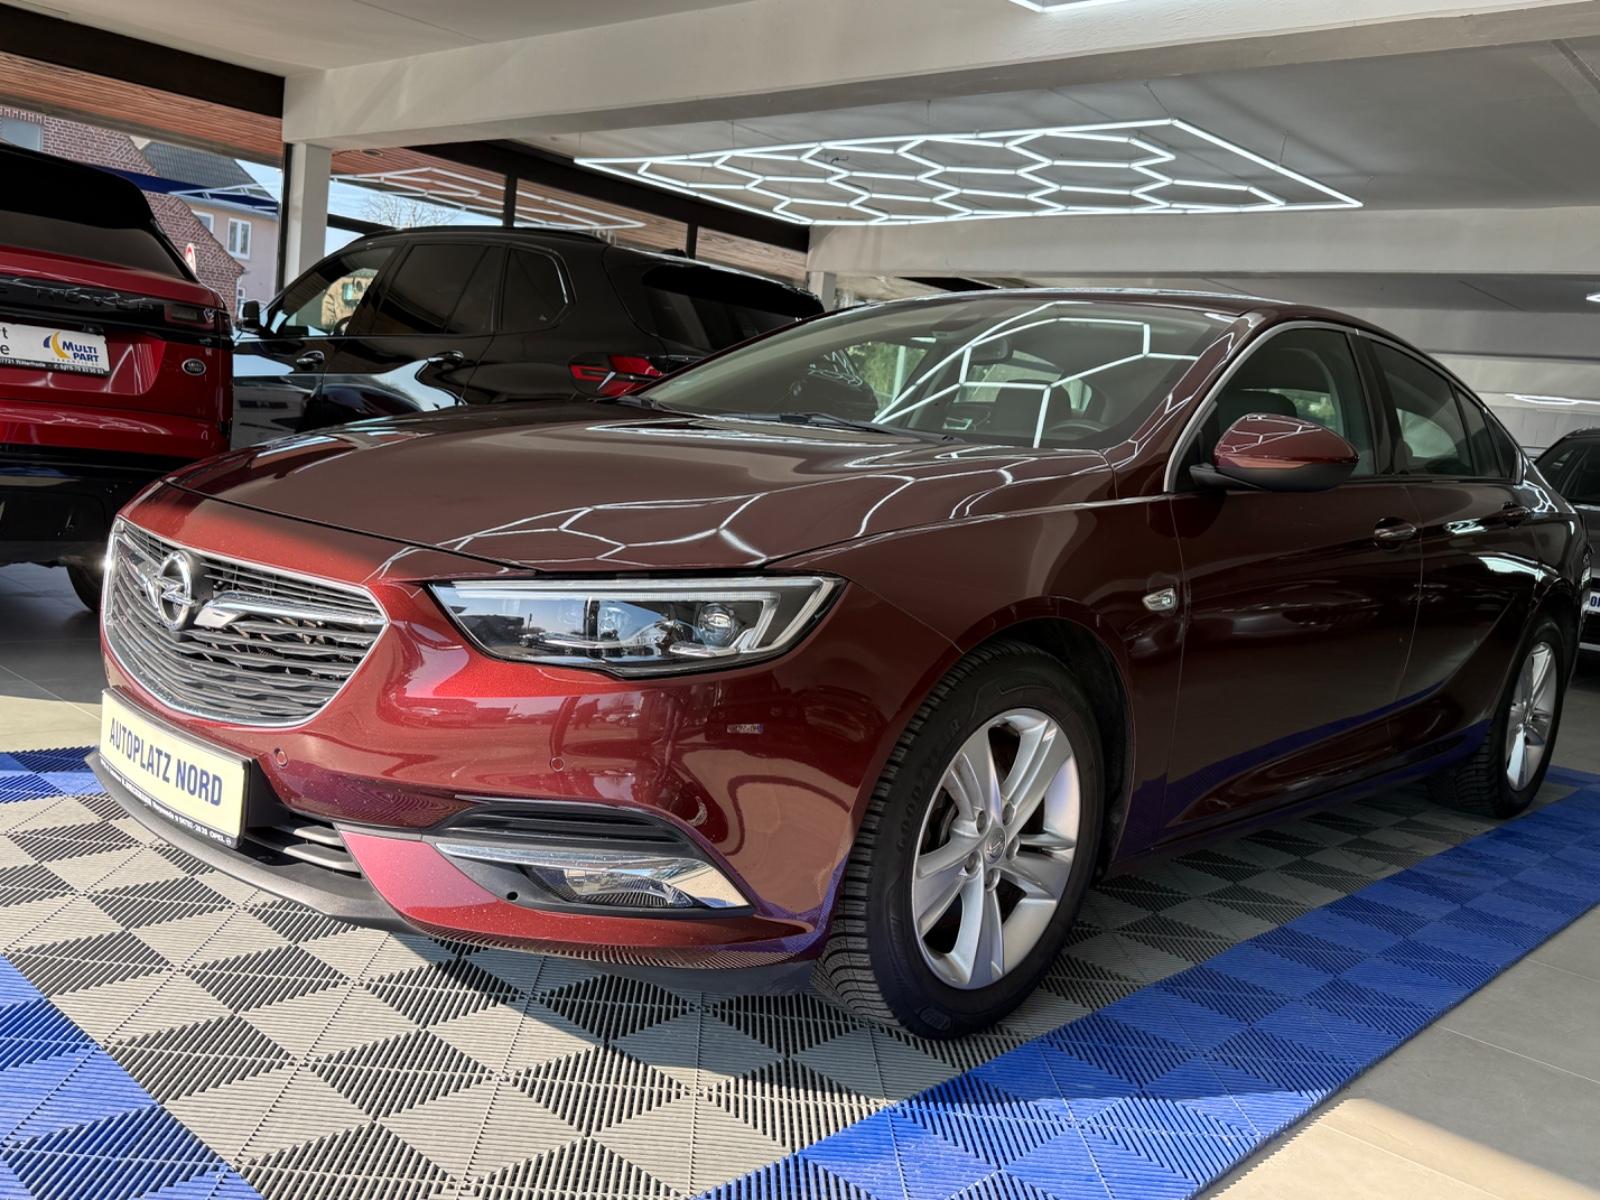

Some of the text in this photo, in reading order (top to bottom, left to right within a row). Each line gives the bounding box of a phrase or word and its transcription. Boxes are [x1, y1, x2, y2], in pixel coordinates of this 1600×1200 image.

[62, 340, 97, 354] MULTI
[72, 352, 99, 362] PART
[109, 717, 172, 783] AUTOPLATZ
[175, 758, 223, 806] NORD
